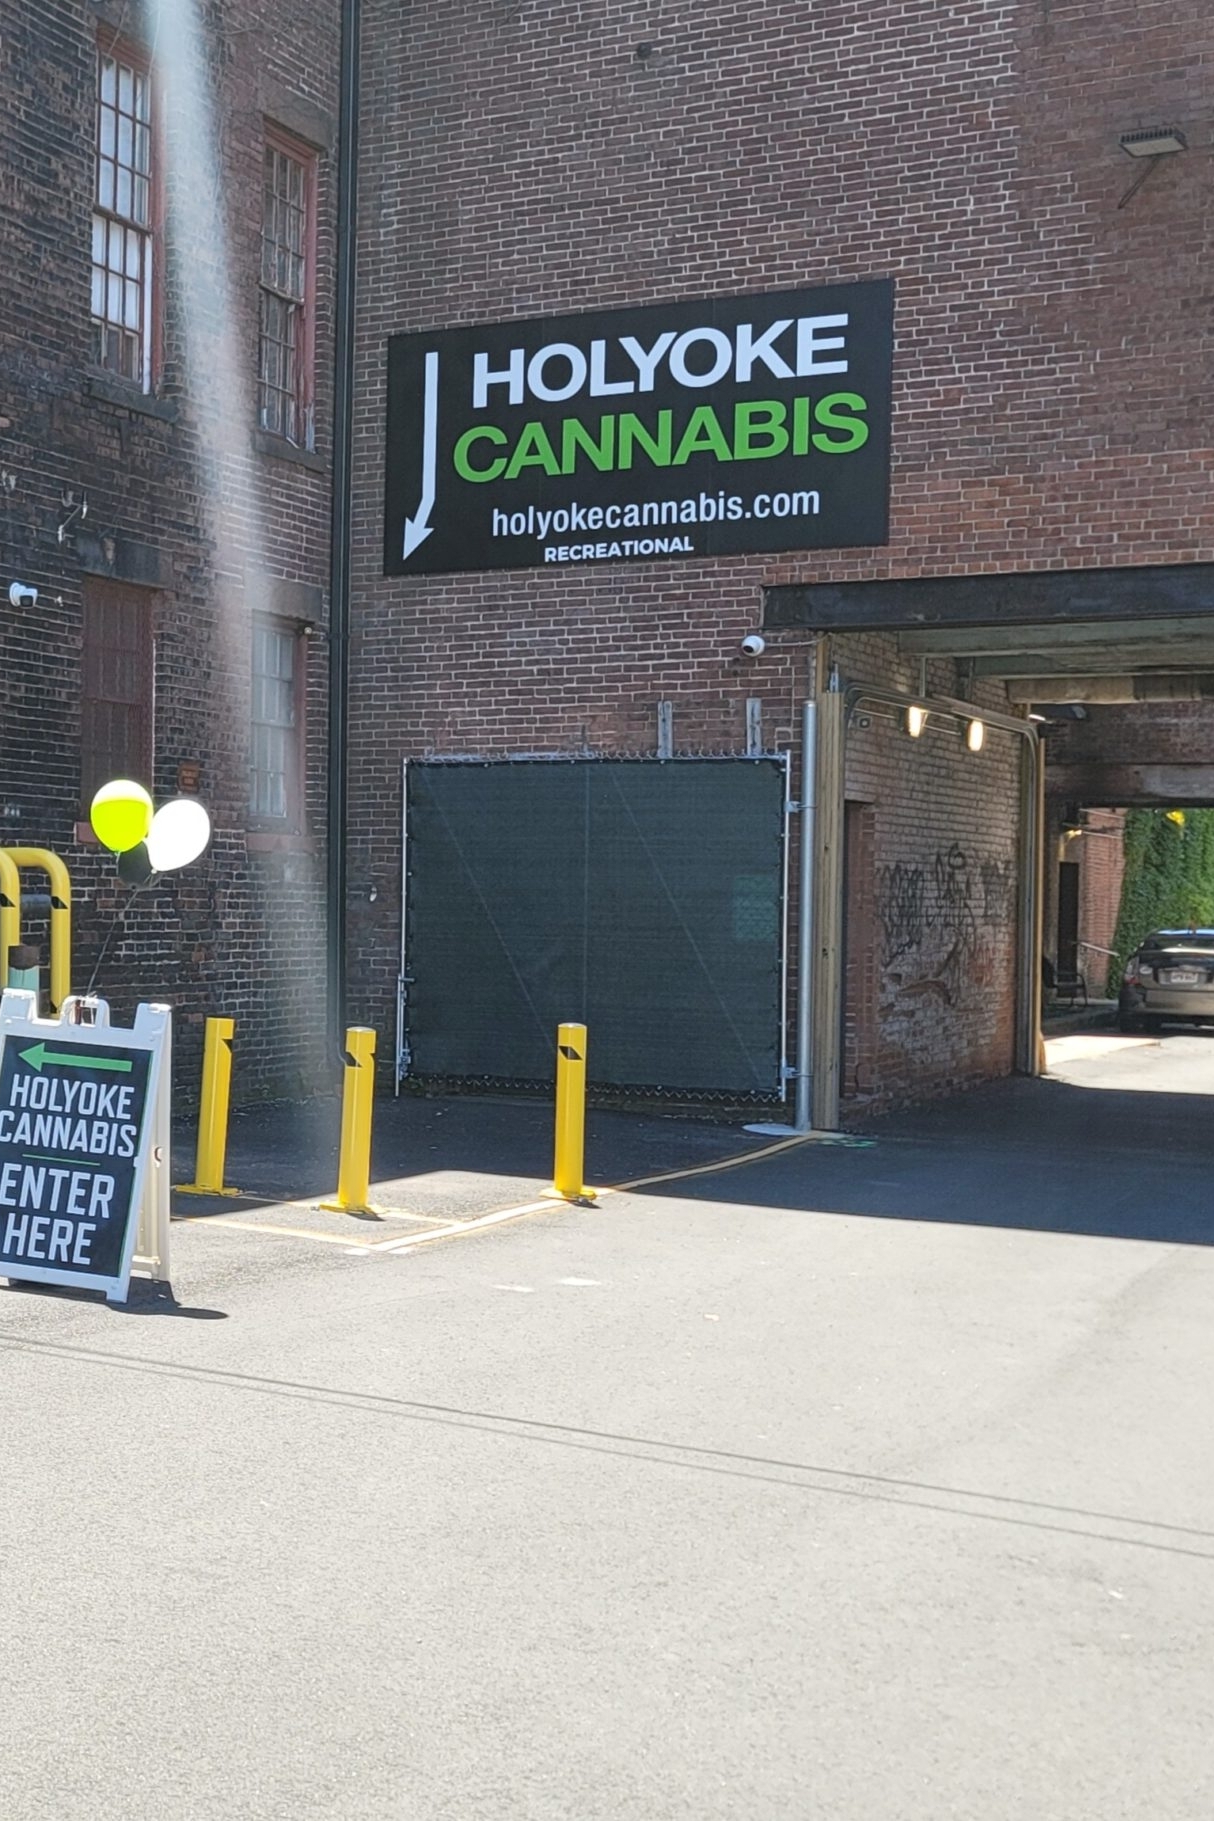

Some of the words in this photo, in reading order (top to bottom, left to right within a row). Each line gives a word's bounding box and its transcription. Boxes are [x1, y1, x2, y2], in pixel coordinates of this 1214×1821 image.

[472, 313, 849, 409] HOLYOKE
[453, 392, 869, 483] CANNABIS
[492, 490, 820, 540] holyokecannabis.com
[544, 536, 694, 563] RECREATIONAL
[9, 1073, 134, 1120] HOLYOKE
[2, 1212, 97, 1265] HERE
